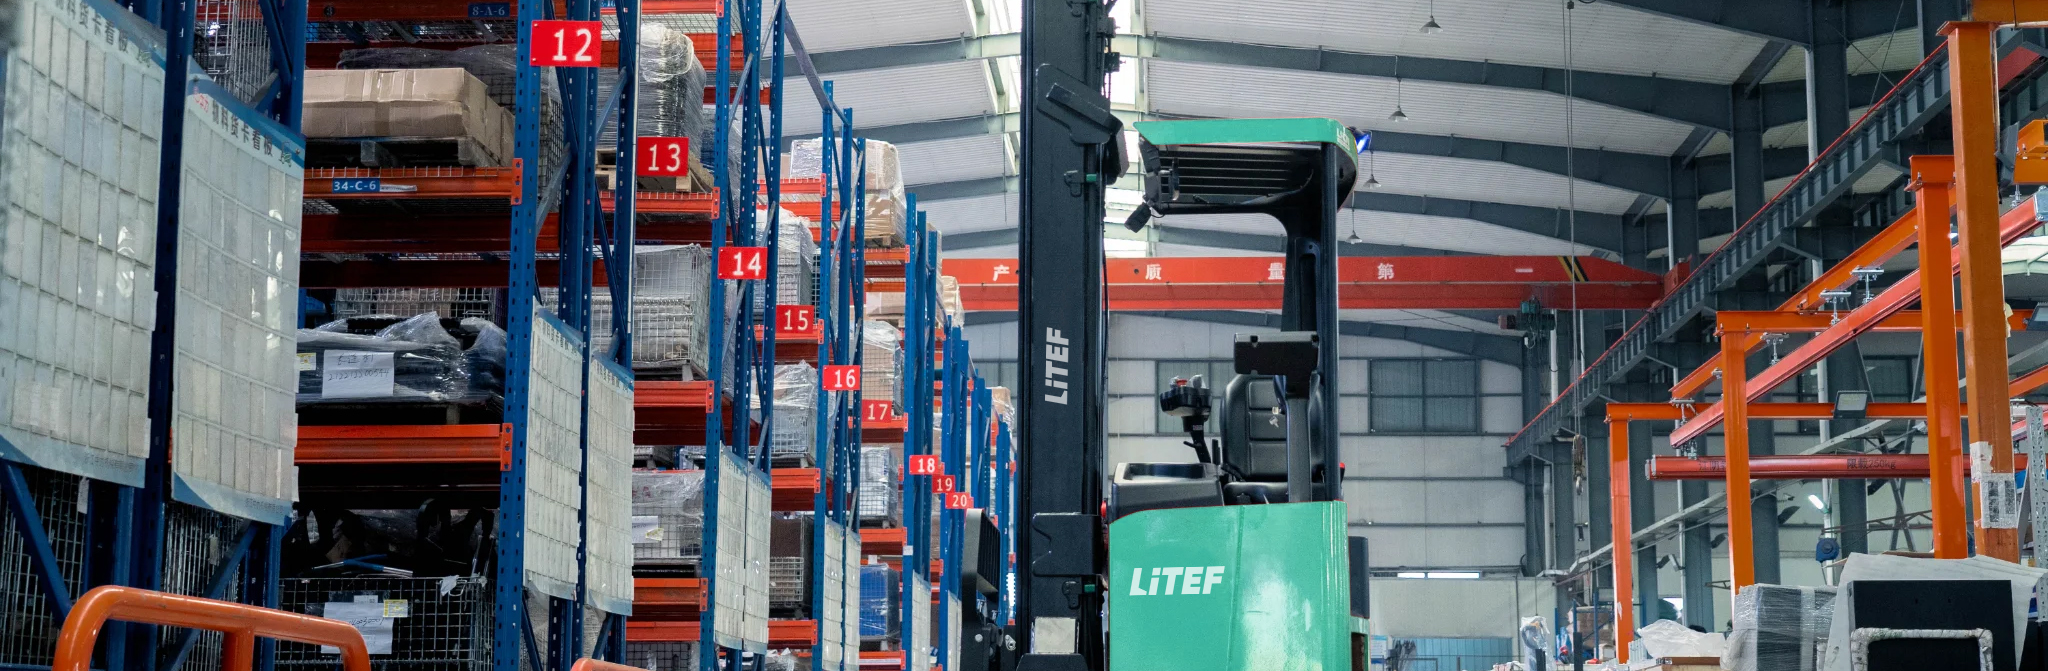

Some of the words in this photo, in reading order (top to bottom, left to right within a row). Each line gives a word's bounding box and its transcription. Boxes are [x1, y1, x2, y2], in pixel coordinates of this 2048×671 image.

[472, 6, 505, 16] 8-A-6
[552, 28, 592, 62] 12
[648, 144, 681, 172] 13
[334, 180, 376, 191] 34-C-6
[733, 252, 762, 276] 14
[993, 264, 1010, 282] 产
[1145, 263, 1162, 280] 质
[1267, 262, 1286, 280] 量
[1377, 263, 1395, 280] 第
[783, 309, 809, 331] 15
[1045, 327, 1069, 405] LiTEF
[834, 369, 856, 388] 16
[867, 404, 889, 420] 17
[917, 458, 936, 473] 18
[936, 478, 953, 492] 19
[952, 495, 967, 507] 20
[1129, 566, 1225, 596] LiTEF
